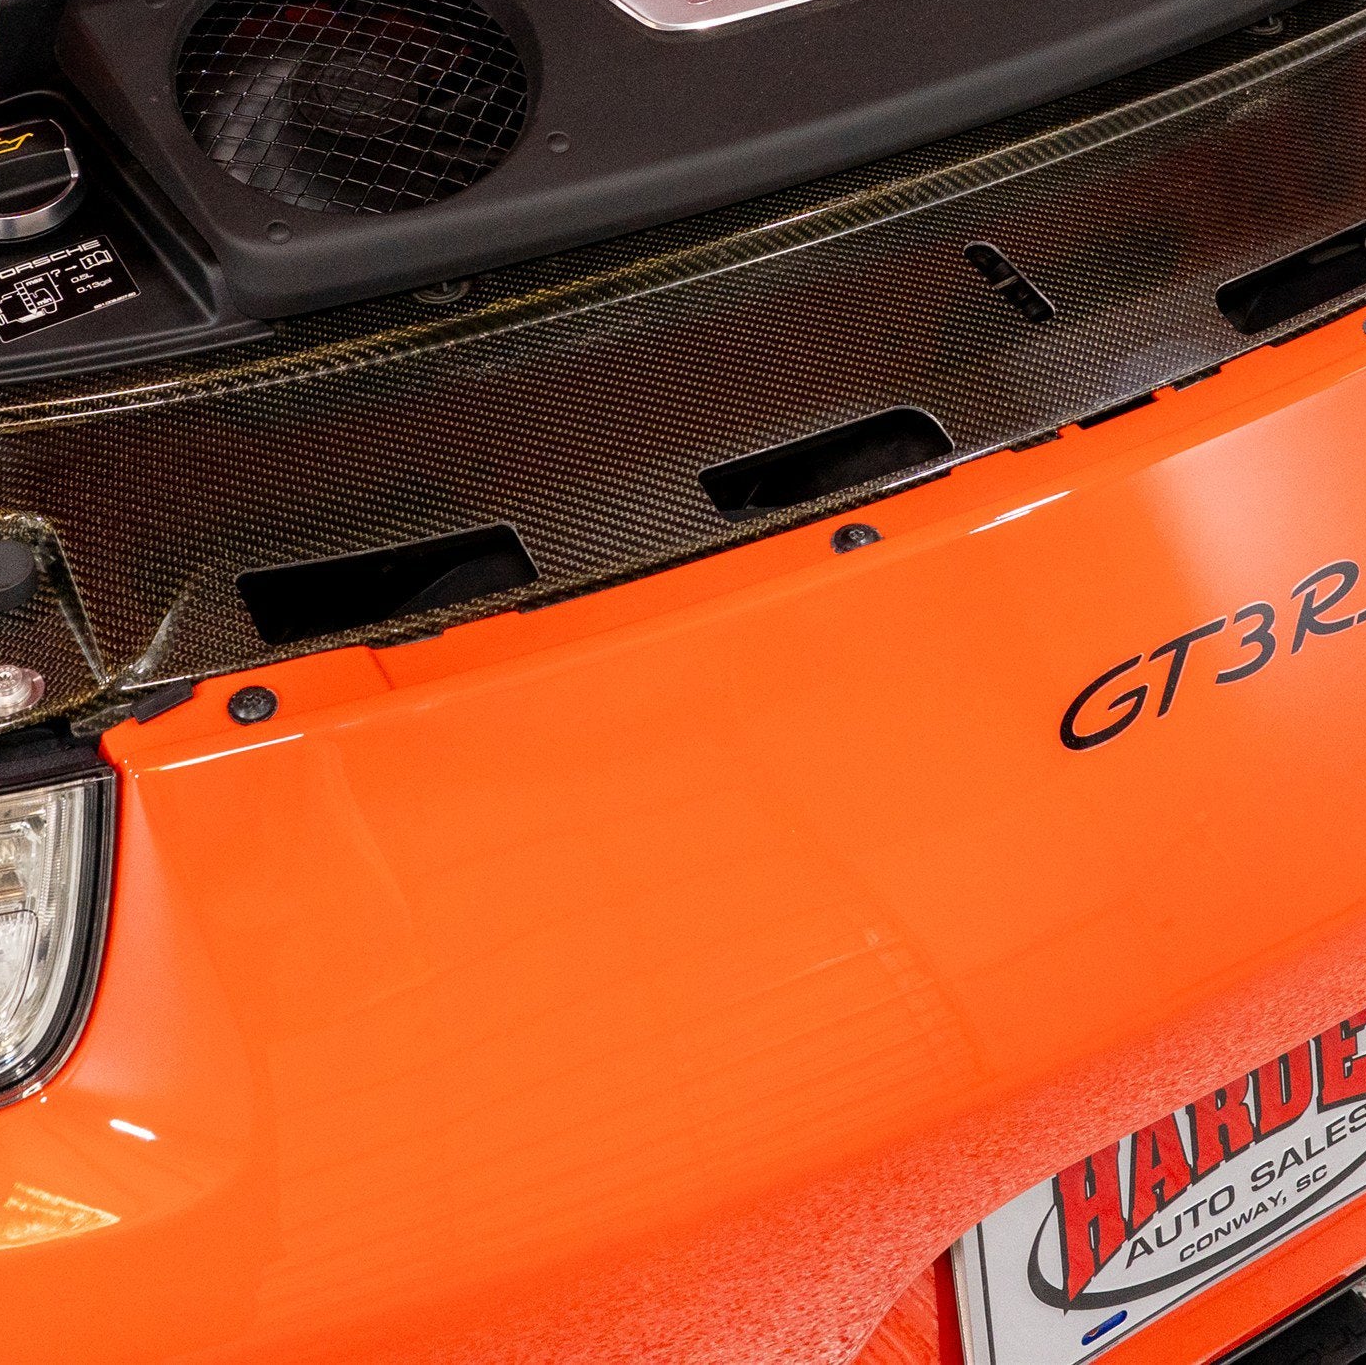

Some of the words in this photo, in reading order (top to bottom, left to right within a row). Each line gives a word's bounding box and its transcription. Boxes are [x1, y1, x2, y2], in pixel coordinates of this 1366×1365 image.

[25, 276, 45, 287] max
[36, 297, 53, 306] min
[1126, 1185, 1235, 1269] AUTO
[1179, 1190, 1287, 1263] CONWAY,
[1295, 1164, 1328, 1193] SC
